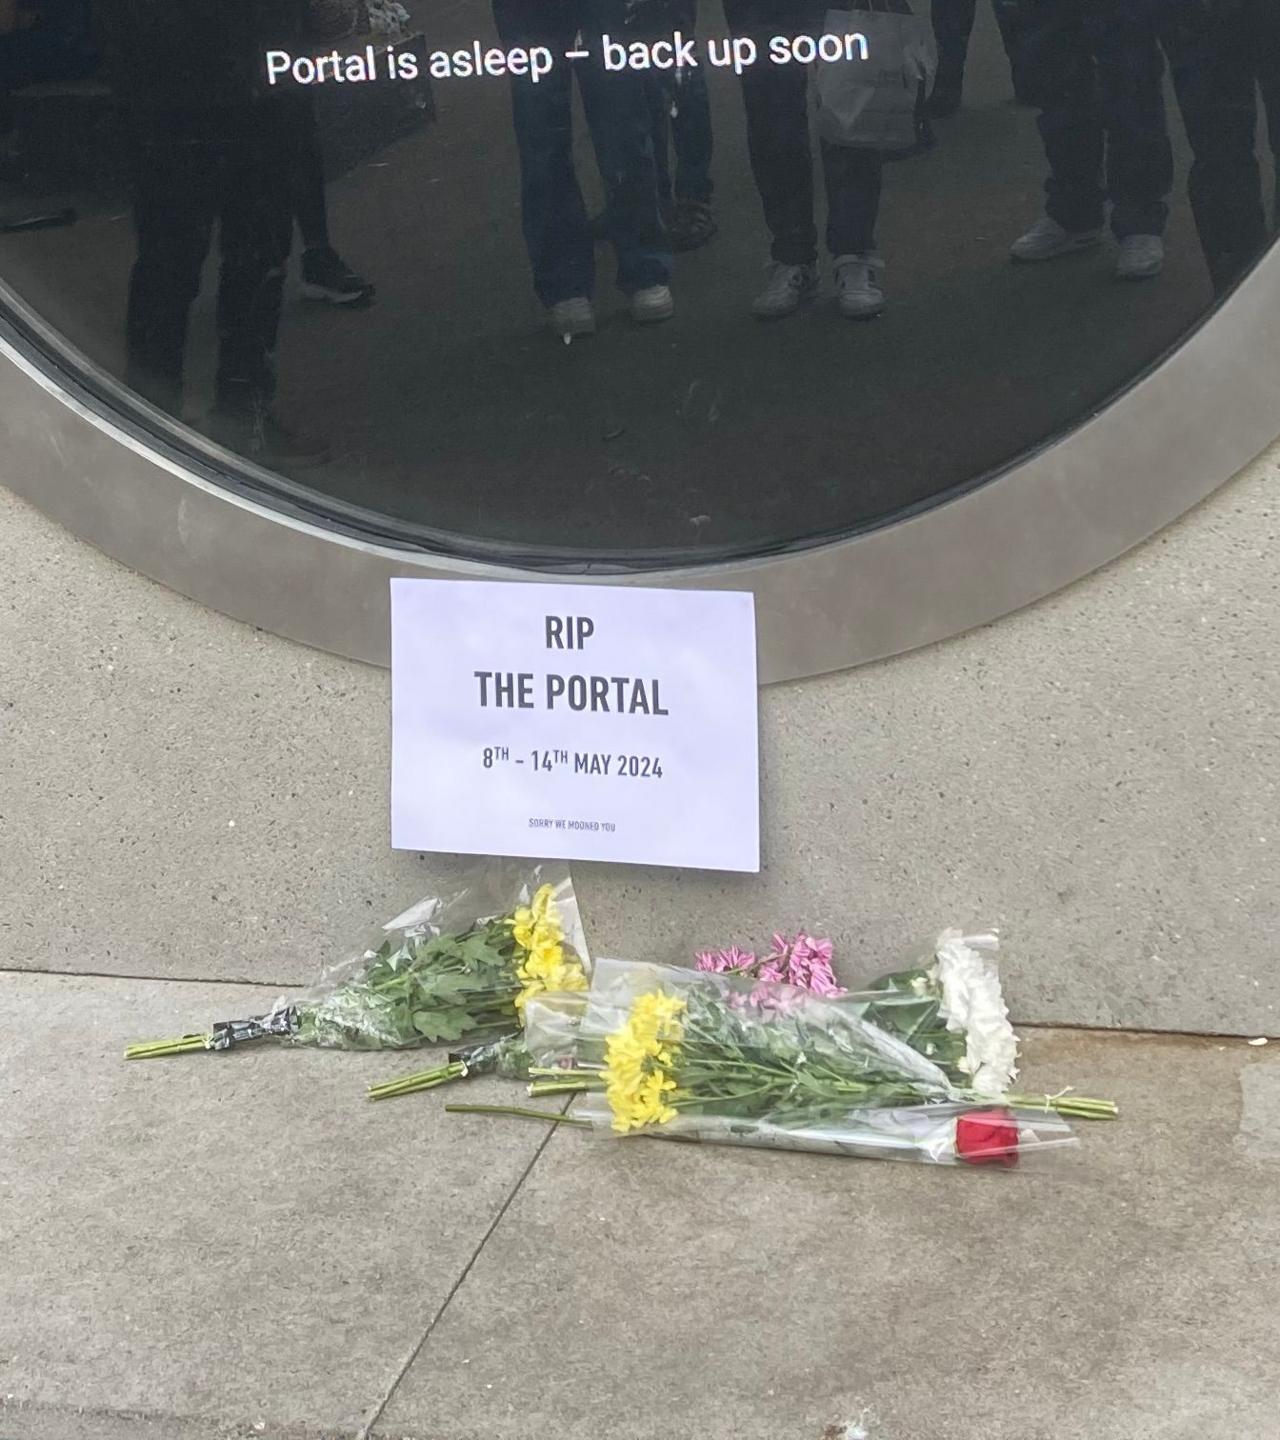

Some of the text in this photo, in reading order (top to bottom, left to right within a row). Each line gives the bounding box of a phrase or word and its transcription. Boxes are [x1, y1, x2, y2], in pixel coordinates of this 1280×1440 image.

[265, 44, 378, 85] Portal
[387, 46, 418, 80] is
[429, 41, 553, 83] asleep
[602, 31, 698, 72] back
[707, 38, 757, 75] up
[768, 32, 870, 65] soon
[544, 614, 595, 651] RIP
[473, 670, 670, 717] THE PORTAL
[482, 745, 510, 769] 8TH
[531, 747, 569, 773] 14TH
[574, 752, 611, 777] MAY
[617, 755, 663, 780] 2024
[528, 817, 553, 829] SORRY
[555, 819, 566, 830] WE
[601, 822, 617, 833] YOU
